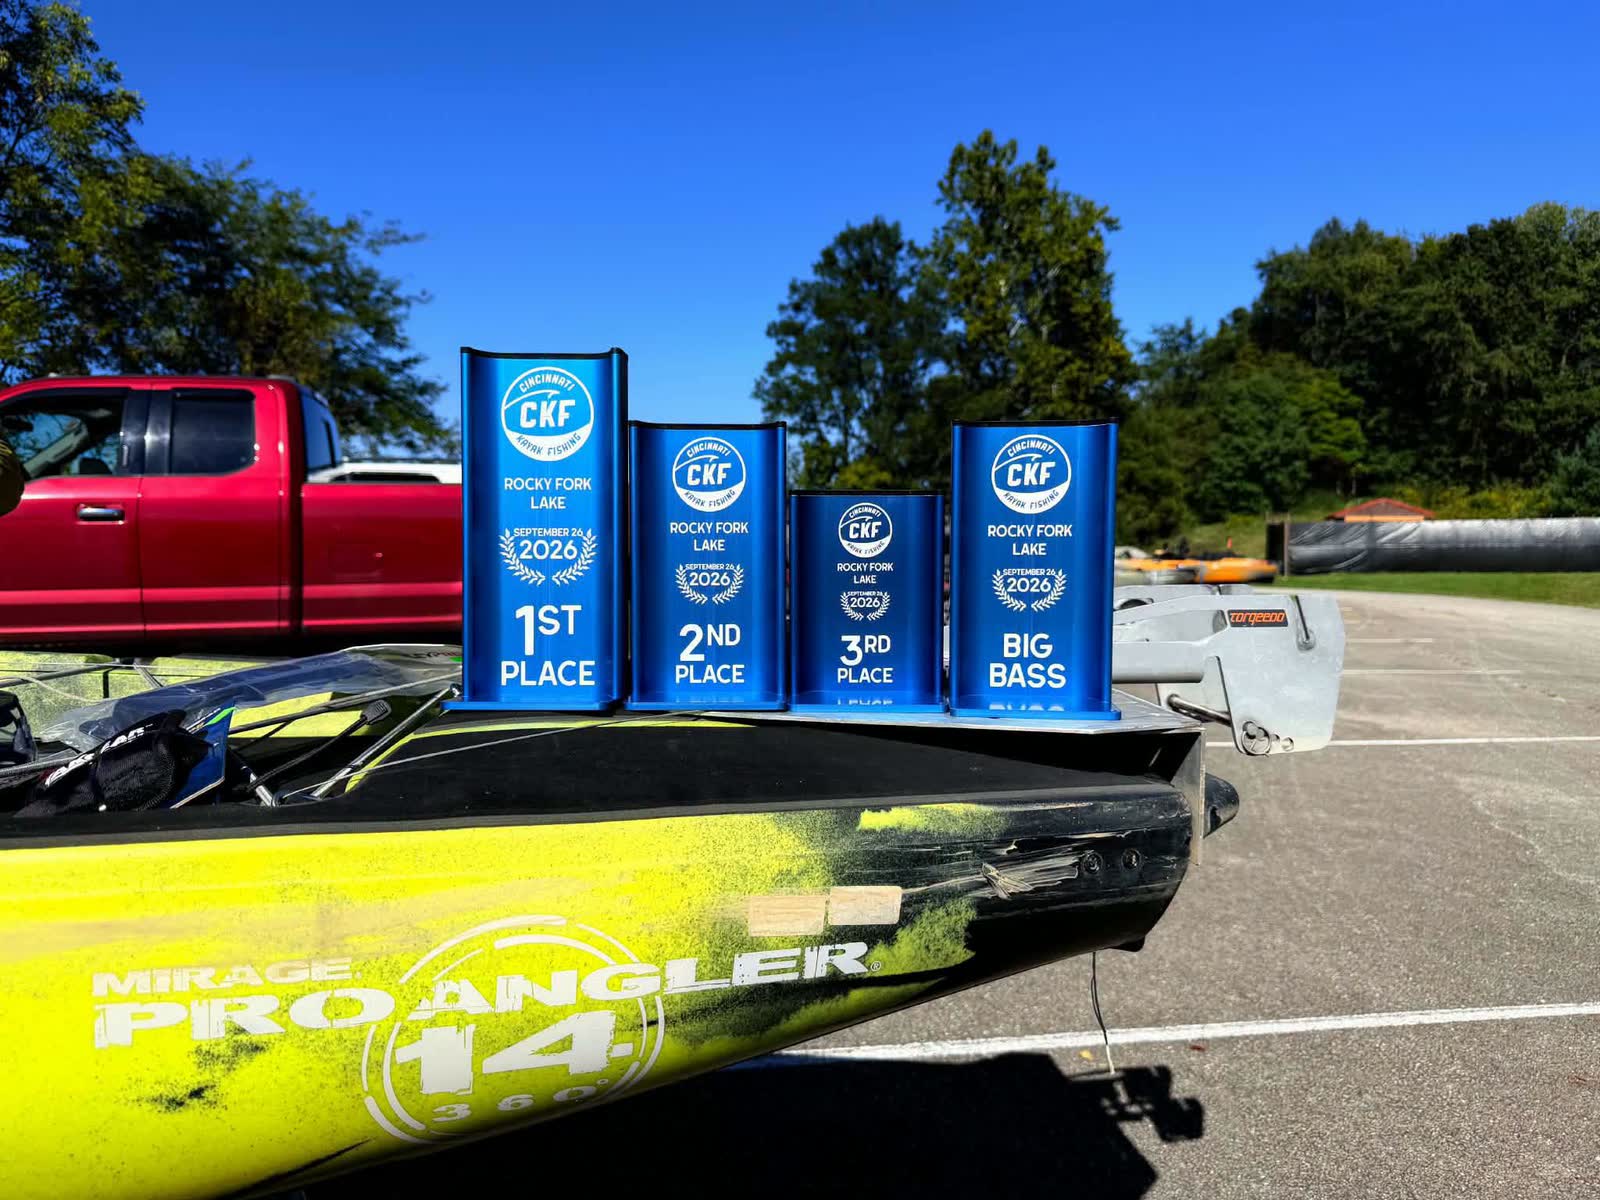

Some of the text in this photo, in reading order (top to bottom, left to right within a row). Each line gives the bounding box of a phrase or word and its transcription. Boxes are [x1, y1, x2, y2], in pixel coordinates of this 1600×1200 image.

[519, 373, 575, 394] CINCINNATI
[520, 399, 576, 428] CKF
[516, 432, 582, 457] KAYAK FISHING
[686, 442, 731, 458] CINCINNATI
[1008, 440, 1054, 458] CINCINNATI
[686, 463, 732, 486] CKF
[1007, 461, 1056, 487] CKF
[505, 478, 591, 490] ROCKY FORK
[531, 497, 565, 509] LAKE
[684, 489, 736, 508] KAYAK FISHING
[1004, 490, 1059, 509] KAYAK FISHING
[513, 528, 584, 537] SEPTEMBER 26
[670, 522, 748, 534] ROCKY FORK
[849, 521, 882, 539] CKF
[988, 525, 1072, 537] ROCKY FORK
[518, 540, 577, 560] 2026
[694, 540, 725, 551] LAKE
[1013, 543, 1046, 555] LAKE
[837, 563, 893, 571] ROCKY FORK
[1003, 568, 1056, 576] SEPTEMBER 26
[690, 572, 730, 586] 2026
[854, 575, 876, 583] LAKE
[1007, 578, 1052, 593] 2026
[850, 597, 881, 609] 2026
[516, 605, 581, 655] 1ST
[680, 624, 740, 661] 2ND
[840, 635, 890, 666] 3RD
[1004, 634, 1052, 658] BIG
[501, 661, 595, 686] PLACE
[676, 664, 744, 683] PLACE
[838, 668, 893, 683] PLACE
[990, 663, 1066, 688] BASS
[92, 957, 354, 997] MIRAGE
[93, 987, 396, 1050] PRO
[394, 1009, 634, 1096] 14
